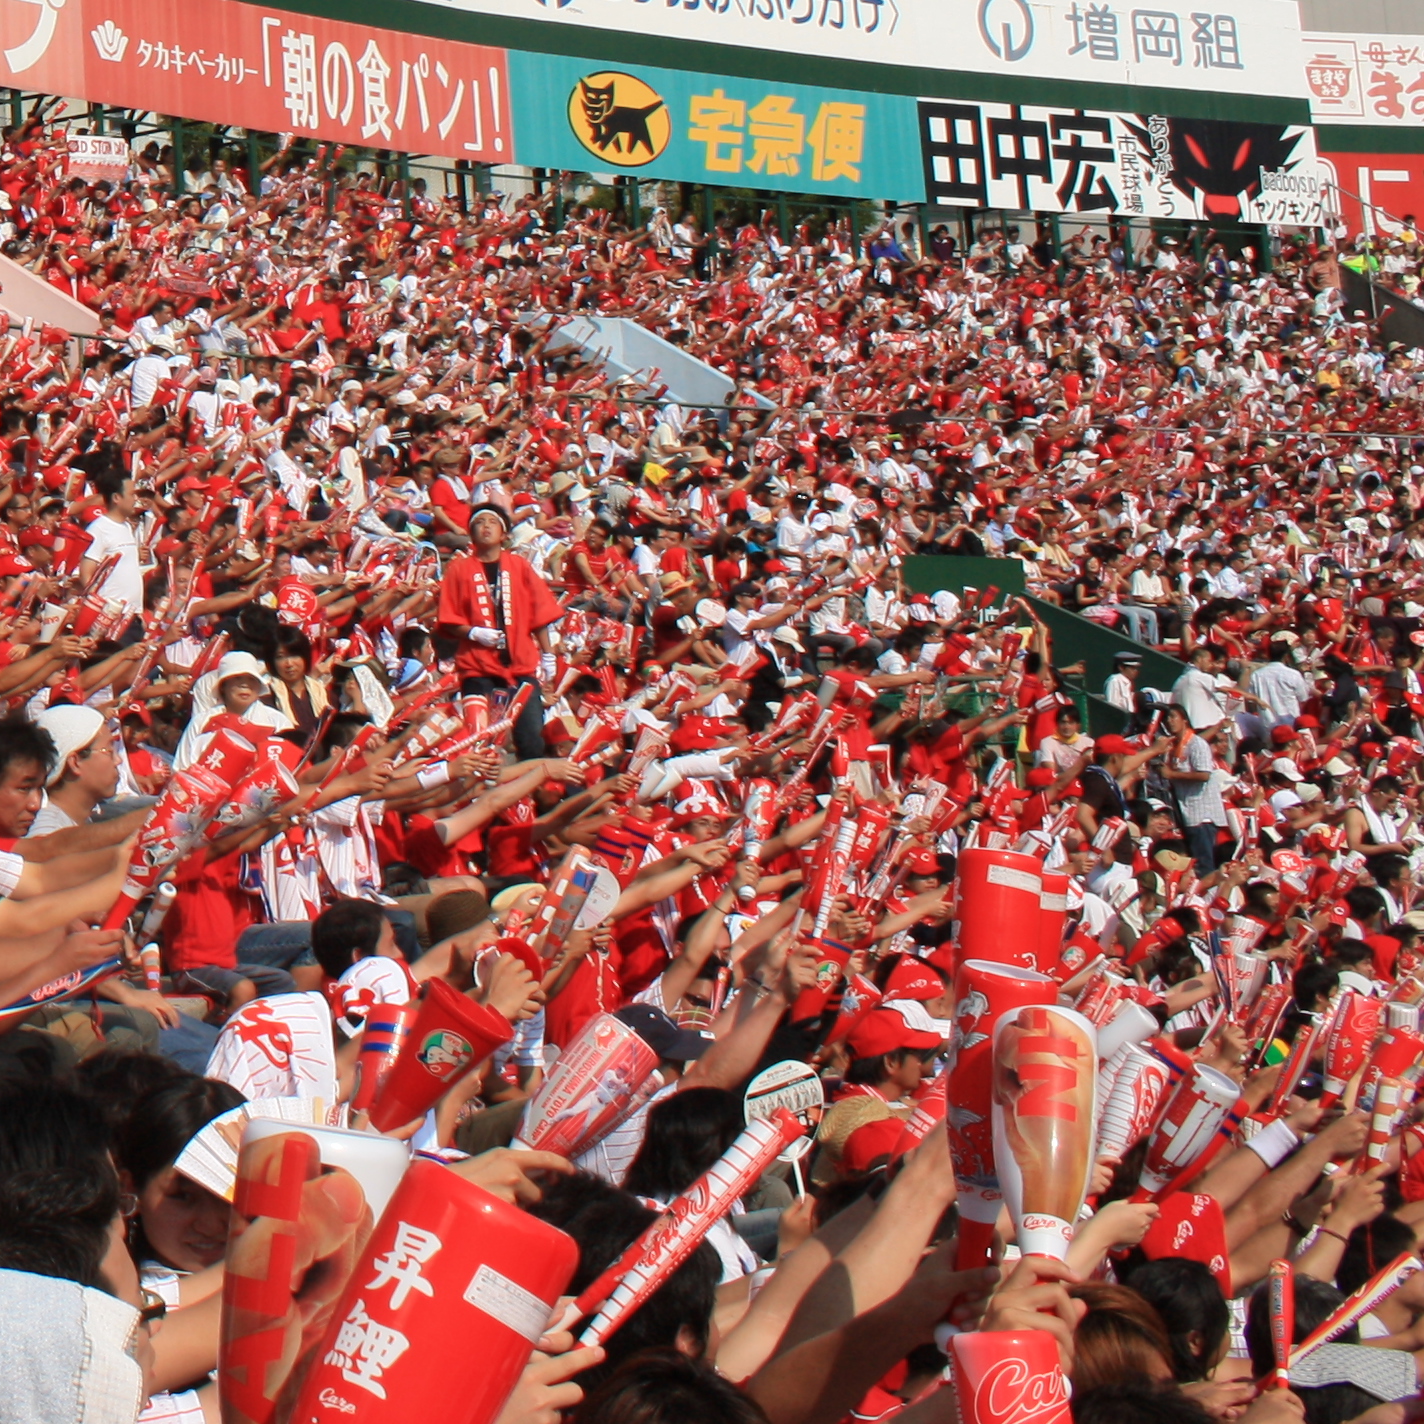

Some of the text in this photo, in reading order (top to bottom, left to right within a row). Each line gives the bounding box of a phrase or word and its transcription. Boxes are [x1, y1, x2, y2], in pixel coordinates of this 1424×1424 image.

[1066, 1, 1245, 70] 増岡組
[136, 37, 259, 86] タカキベーカリー
[1310, 69, 1346, 87] ますや
[688, 88, 866, 183] 宅急便
[918, 101, 1120, 214] 田中宏
[1116, 133, 1145, 214] 市民球場
[1147, 114, 1175, 217] ありがとう
[1253, 198, 1323, 224] ヤングキング
[563, 1049, 604, 1095] HIROSHIMA
[546, 1095, 569, 1119] TOYO
[1022, 1215, 1057, 1231] Carp
[323, 1220, 443, 1401] 昇鯉
[1351, 1282, 1401, 1326] HIROSHIMA
[318, 1387, 357, 1415] Carp
